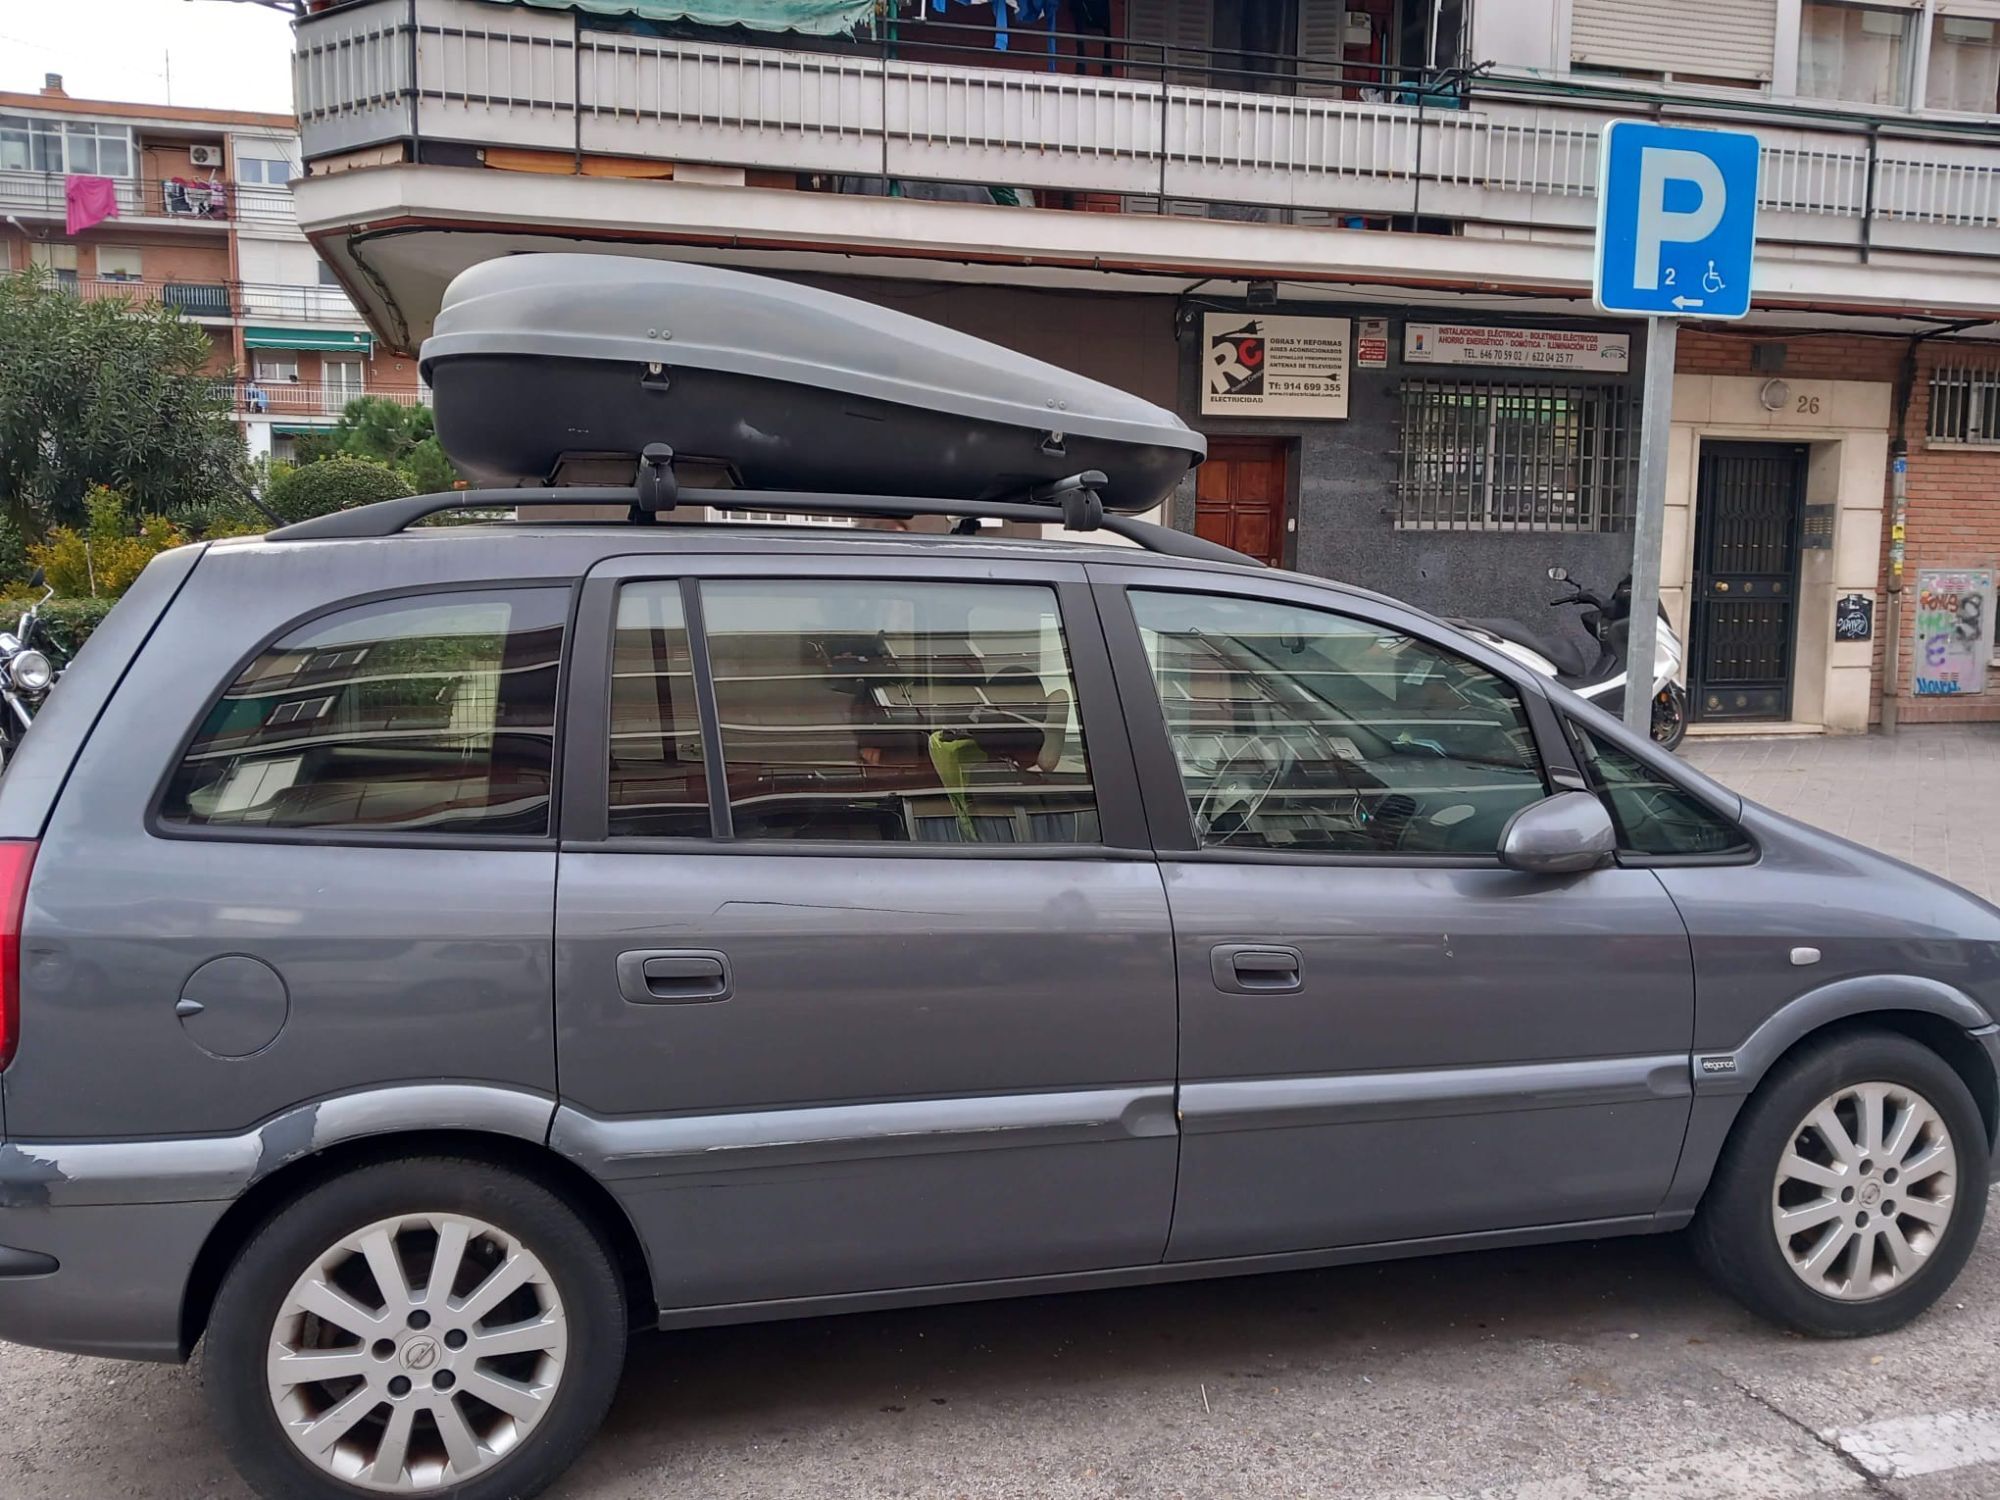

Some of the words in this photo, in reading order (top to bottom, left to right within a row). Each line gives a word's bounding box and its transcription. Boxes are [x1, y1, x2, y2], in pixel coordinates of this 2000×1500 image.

[1633, 146, 1727, 290] P
[1664, 267, 1676, 285] 2
[1438, 328, 1485, 337] INSTALACIONES
[1530, 332, 1561, 341] BOLETINES
[1438, 336, 1465, 345] AHORRO
[1464, 348, 1478, 359] TEL.
[1480, 350, 1493, 360] 646
[1494, 350, 1503, 360] 70
[1504, 351, 1512, 360] 59
[1513, 351, 1522, 361] 02
[1532, 352, 1544, 362] 622
[1545, 353, 1554, 362] 04
[1555, 354, 1564, 363] 25
[1565, 354, 1574, 364] 77
[1268, 381, 1281, 390] Tf:
[1283, 382, 1301, 390] 914
[1303, 383, 1321, 391] 699
[1323, 383, 1341, 392] 355
[1797, 396, 1819, 414] 26
